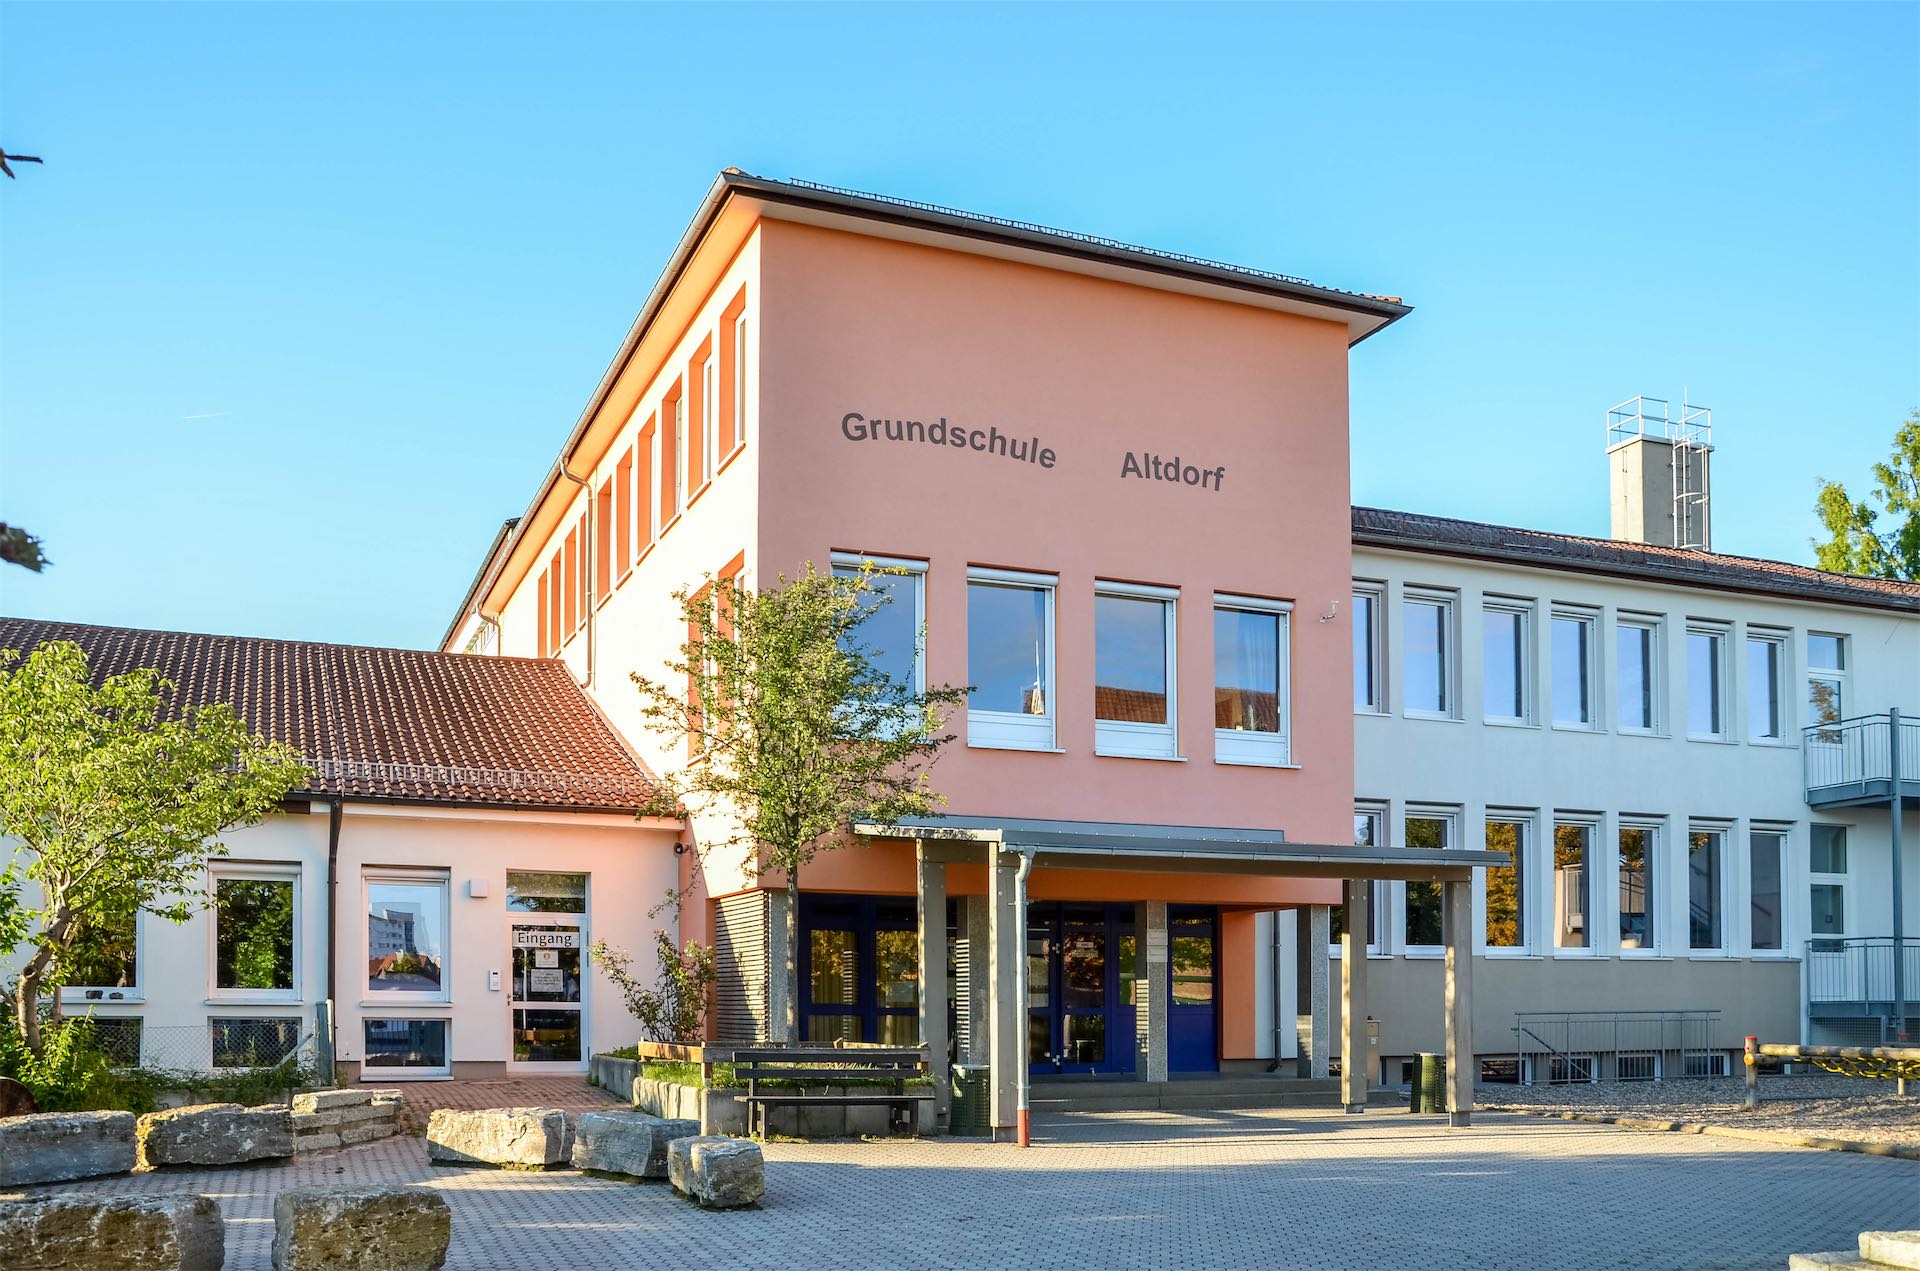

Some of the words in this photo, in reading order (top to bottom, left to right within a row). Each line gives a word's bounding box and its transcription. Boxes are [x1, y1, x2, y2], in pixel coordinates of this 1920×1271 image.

[841, 412, 1057, 469] Grundschule
[1120, 451, 1226, 492] Altdorf
[518, 931, 572, 947] Eingang
